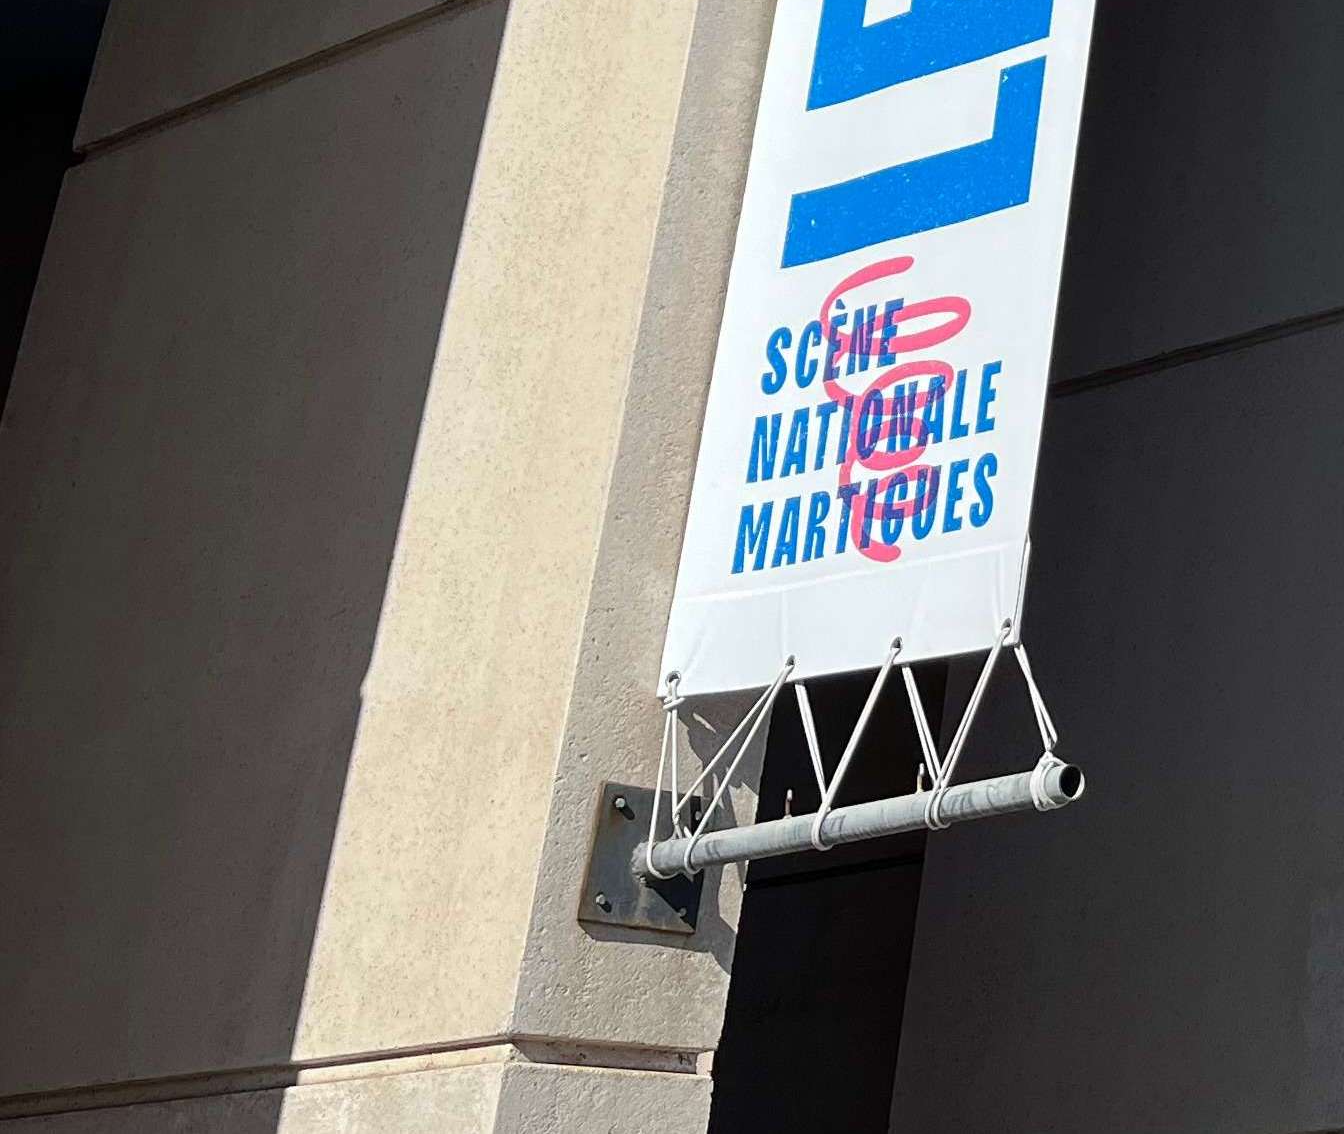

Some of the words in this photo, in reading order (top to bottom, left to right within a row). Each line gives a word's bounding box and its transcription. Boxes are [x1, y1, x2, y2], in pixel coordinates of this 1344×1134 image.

[760, 297, 905, 396] SCÈNE
[745, 360, 1003, 484] NATIONALE
[730, 451, 999, 575] MARTIGUES
